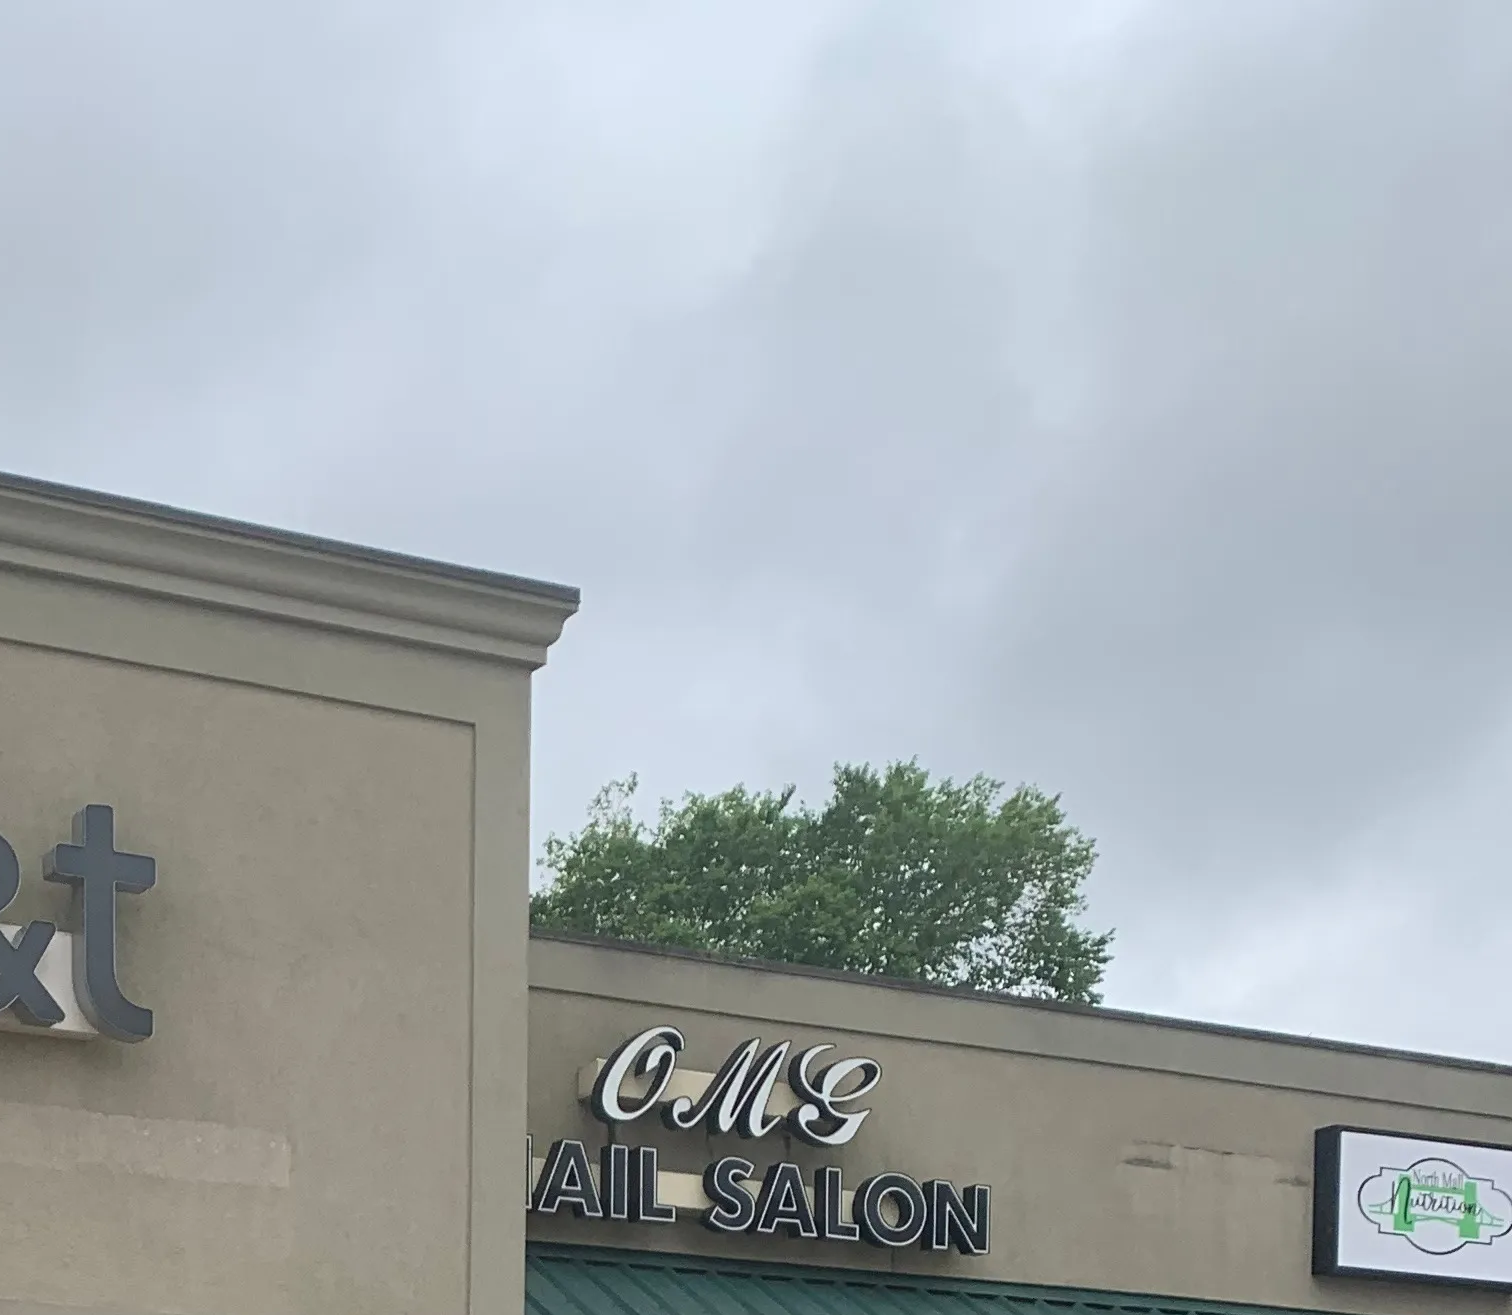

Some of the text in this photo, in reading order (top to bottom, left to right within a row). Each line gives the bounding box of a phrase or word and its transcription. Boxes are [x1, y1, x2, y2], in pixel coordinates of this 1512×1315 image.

[592, 1024, 883, 1146] OMG
[527, 1133, 992, 1256] AIL SALON
[1413, 1168, 1439, 1185] North
